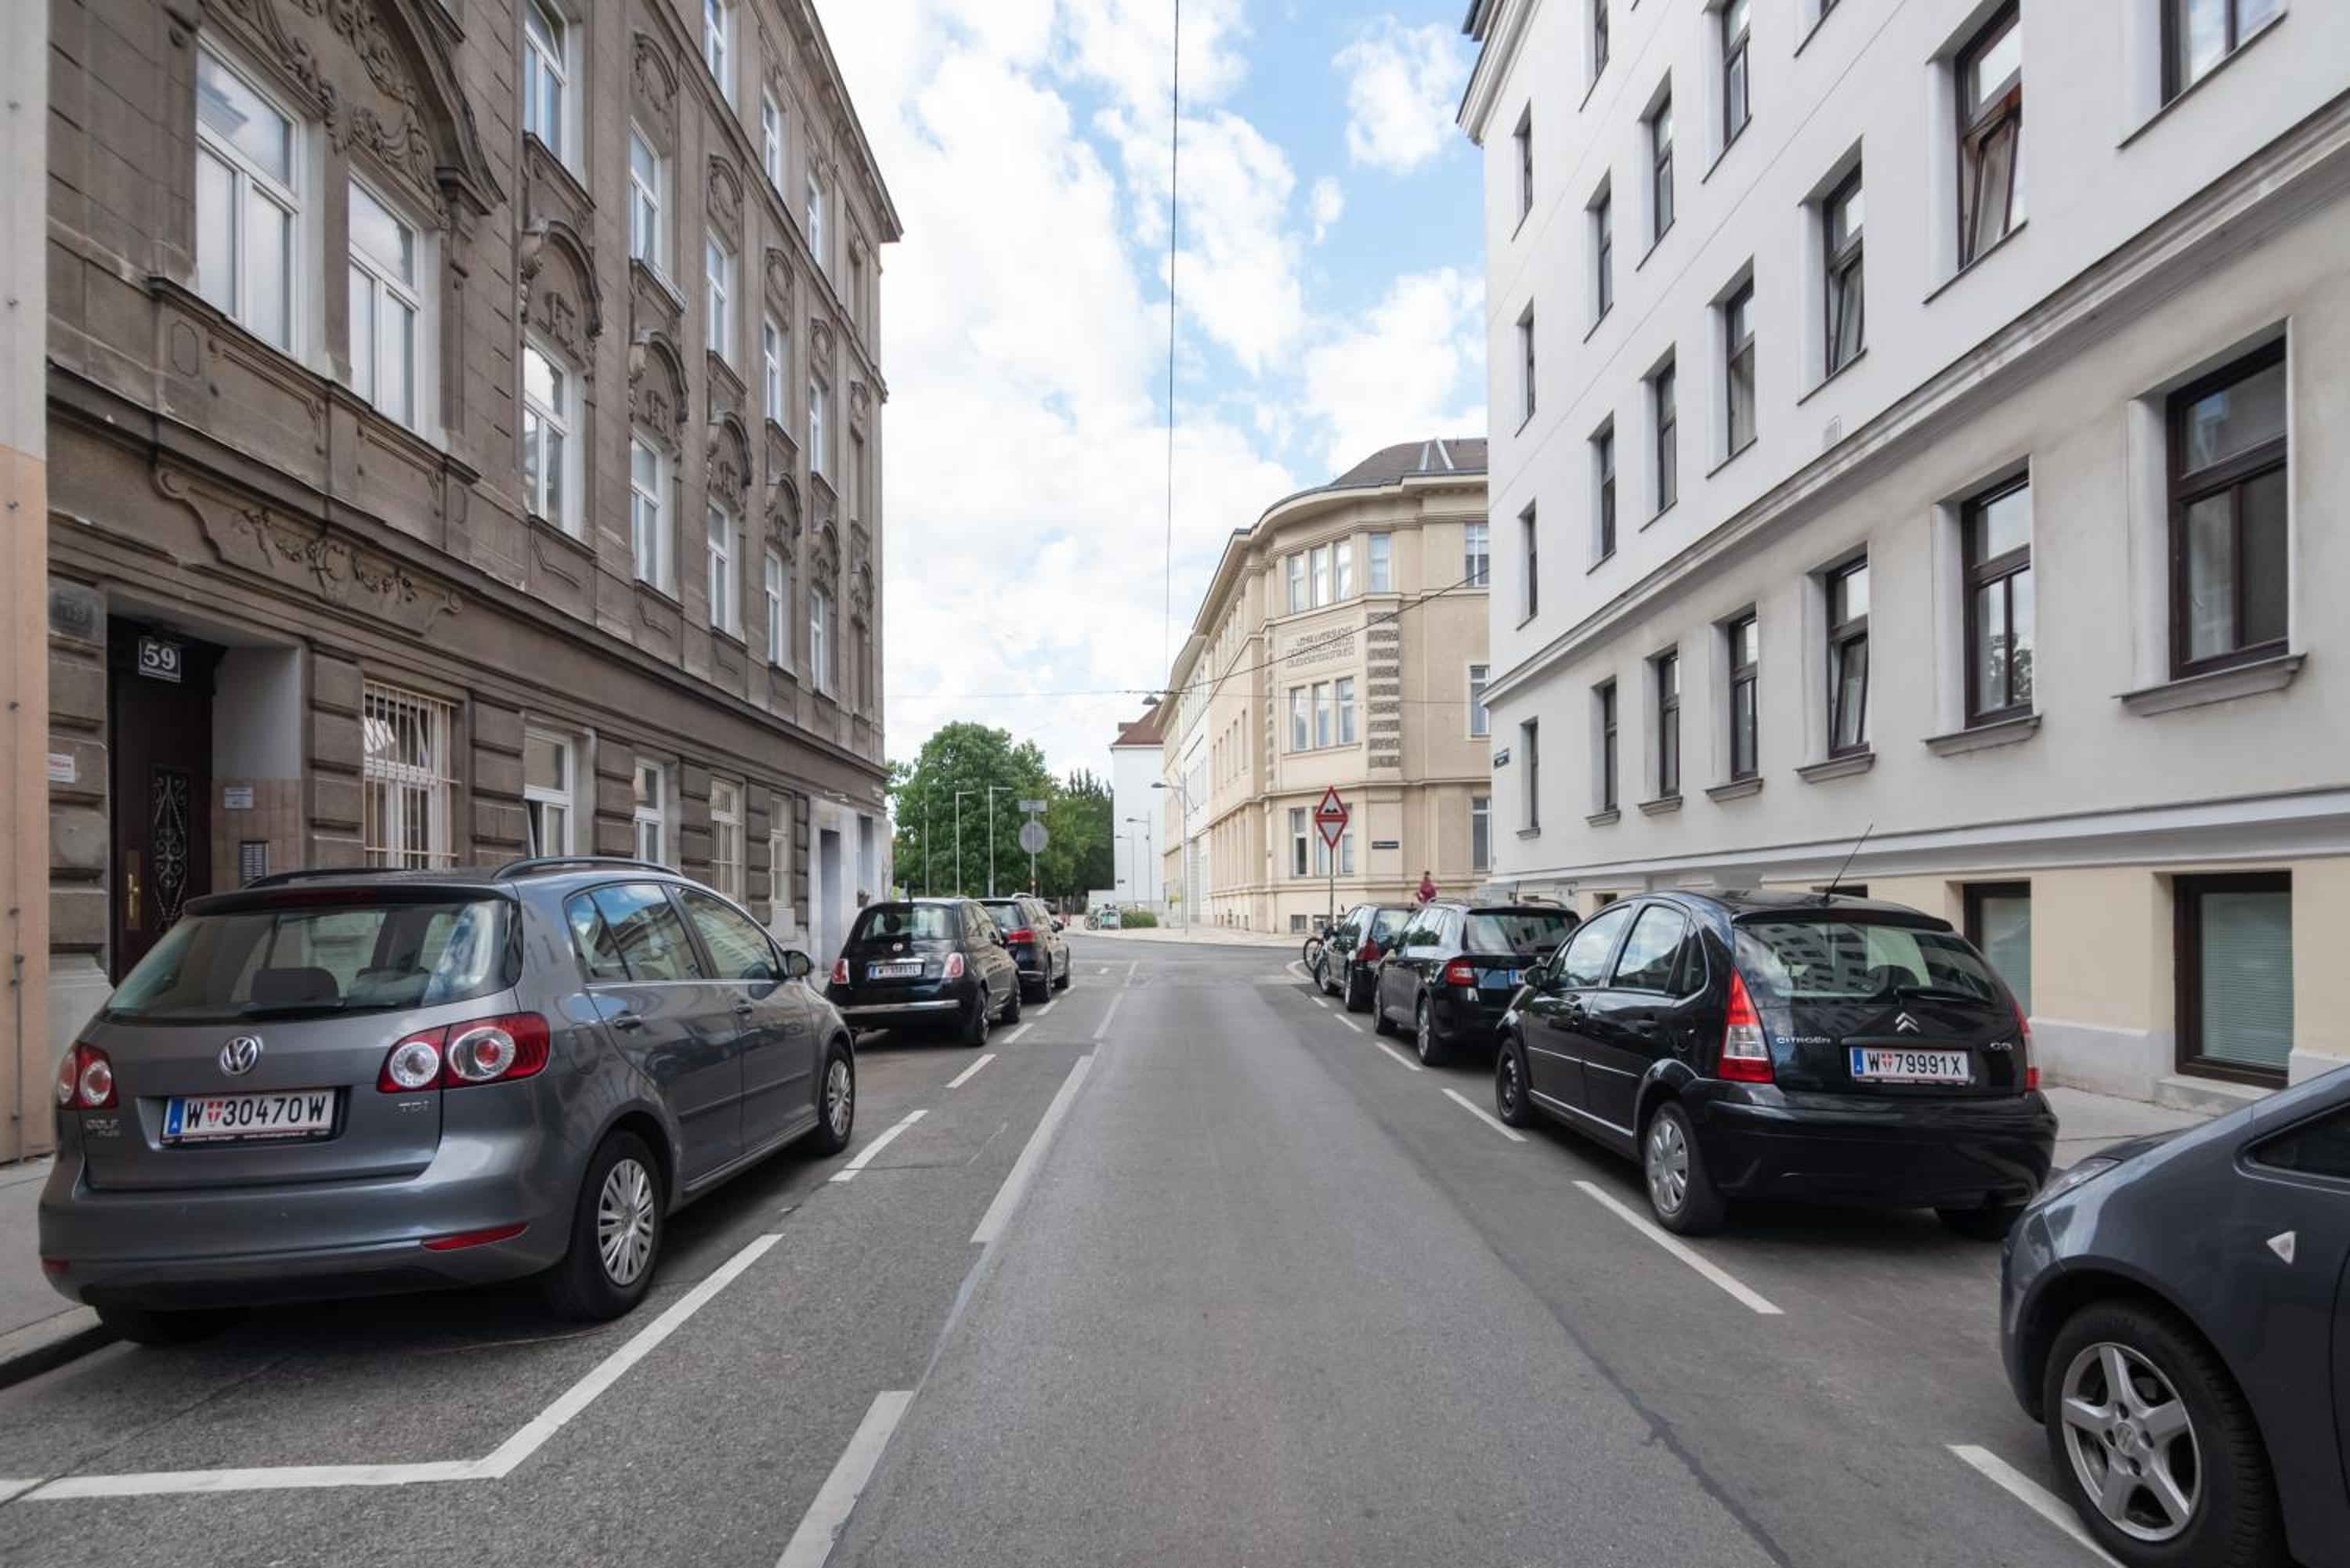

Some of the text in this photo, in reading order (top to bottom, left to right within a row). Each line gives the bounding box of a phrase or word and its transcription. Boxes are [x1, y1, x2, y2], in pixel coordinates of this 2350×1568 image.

[143, 643, 176, 670] 59
[1867, 1053, 1961, 1076] W 79991X
[187, 1096, 326, 1128] W 30470W
